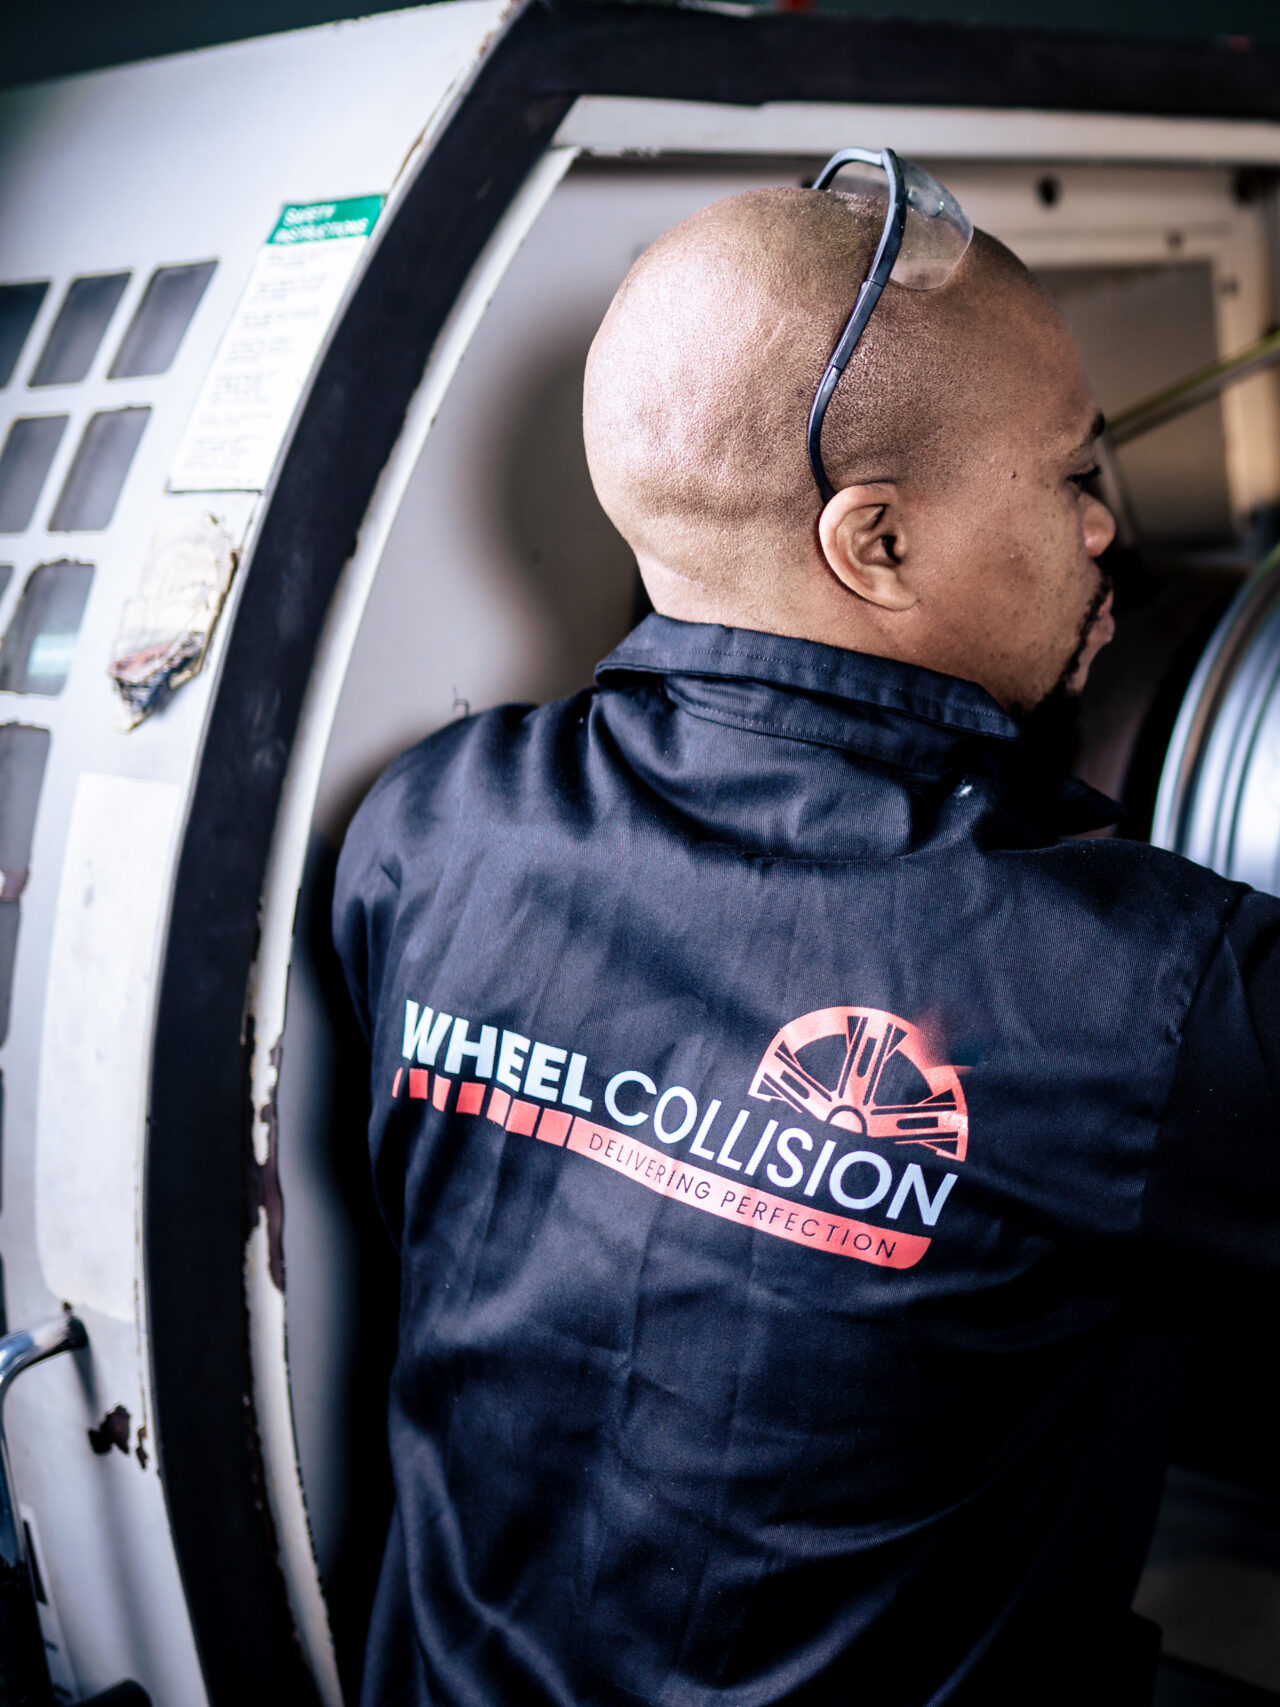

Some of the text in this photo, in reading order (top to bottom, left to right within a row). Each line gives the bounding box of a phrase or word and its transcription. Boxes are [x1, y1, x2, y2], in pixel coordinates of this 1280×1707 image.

[401, 1000, 593, 1112] WHEEL
[589, 1133, 897, 1259] DELIVERING PERFECTION
[604, 1070, 958, 1226] COLLISION
